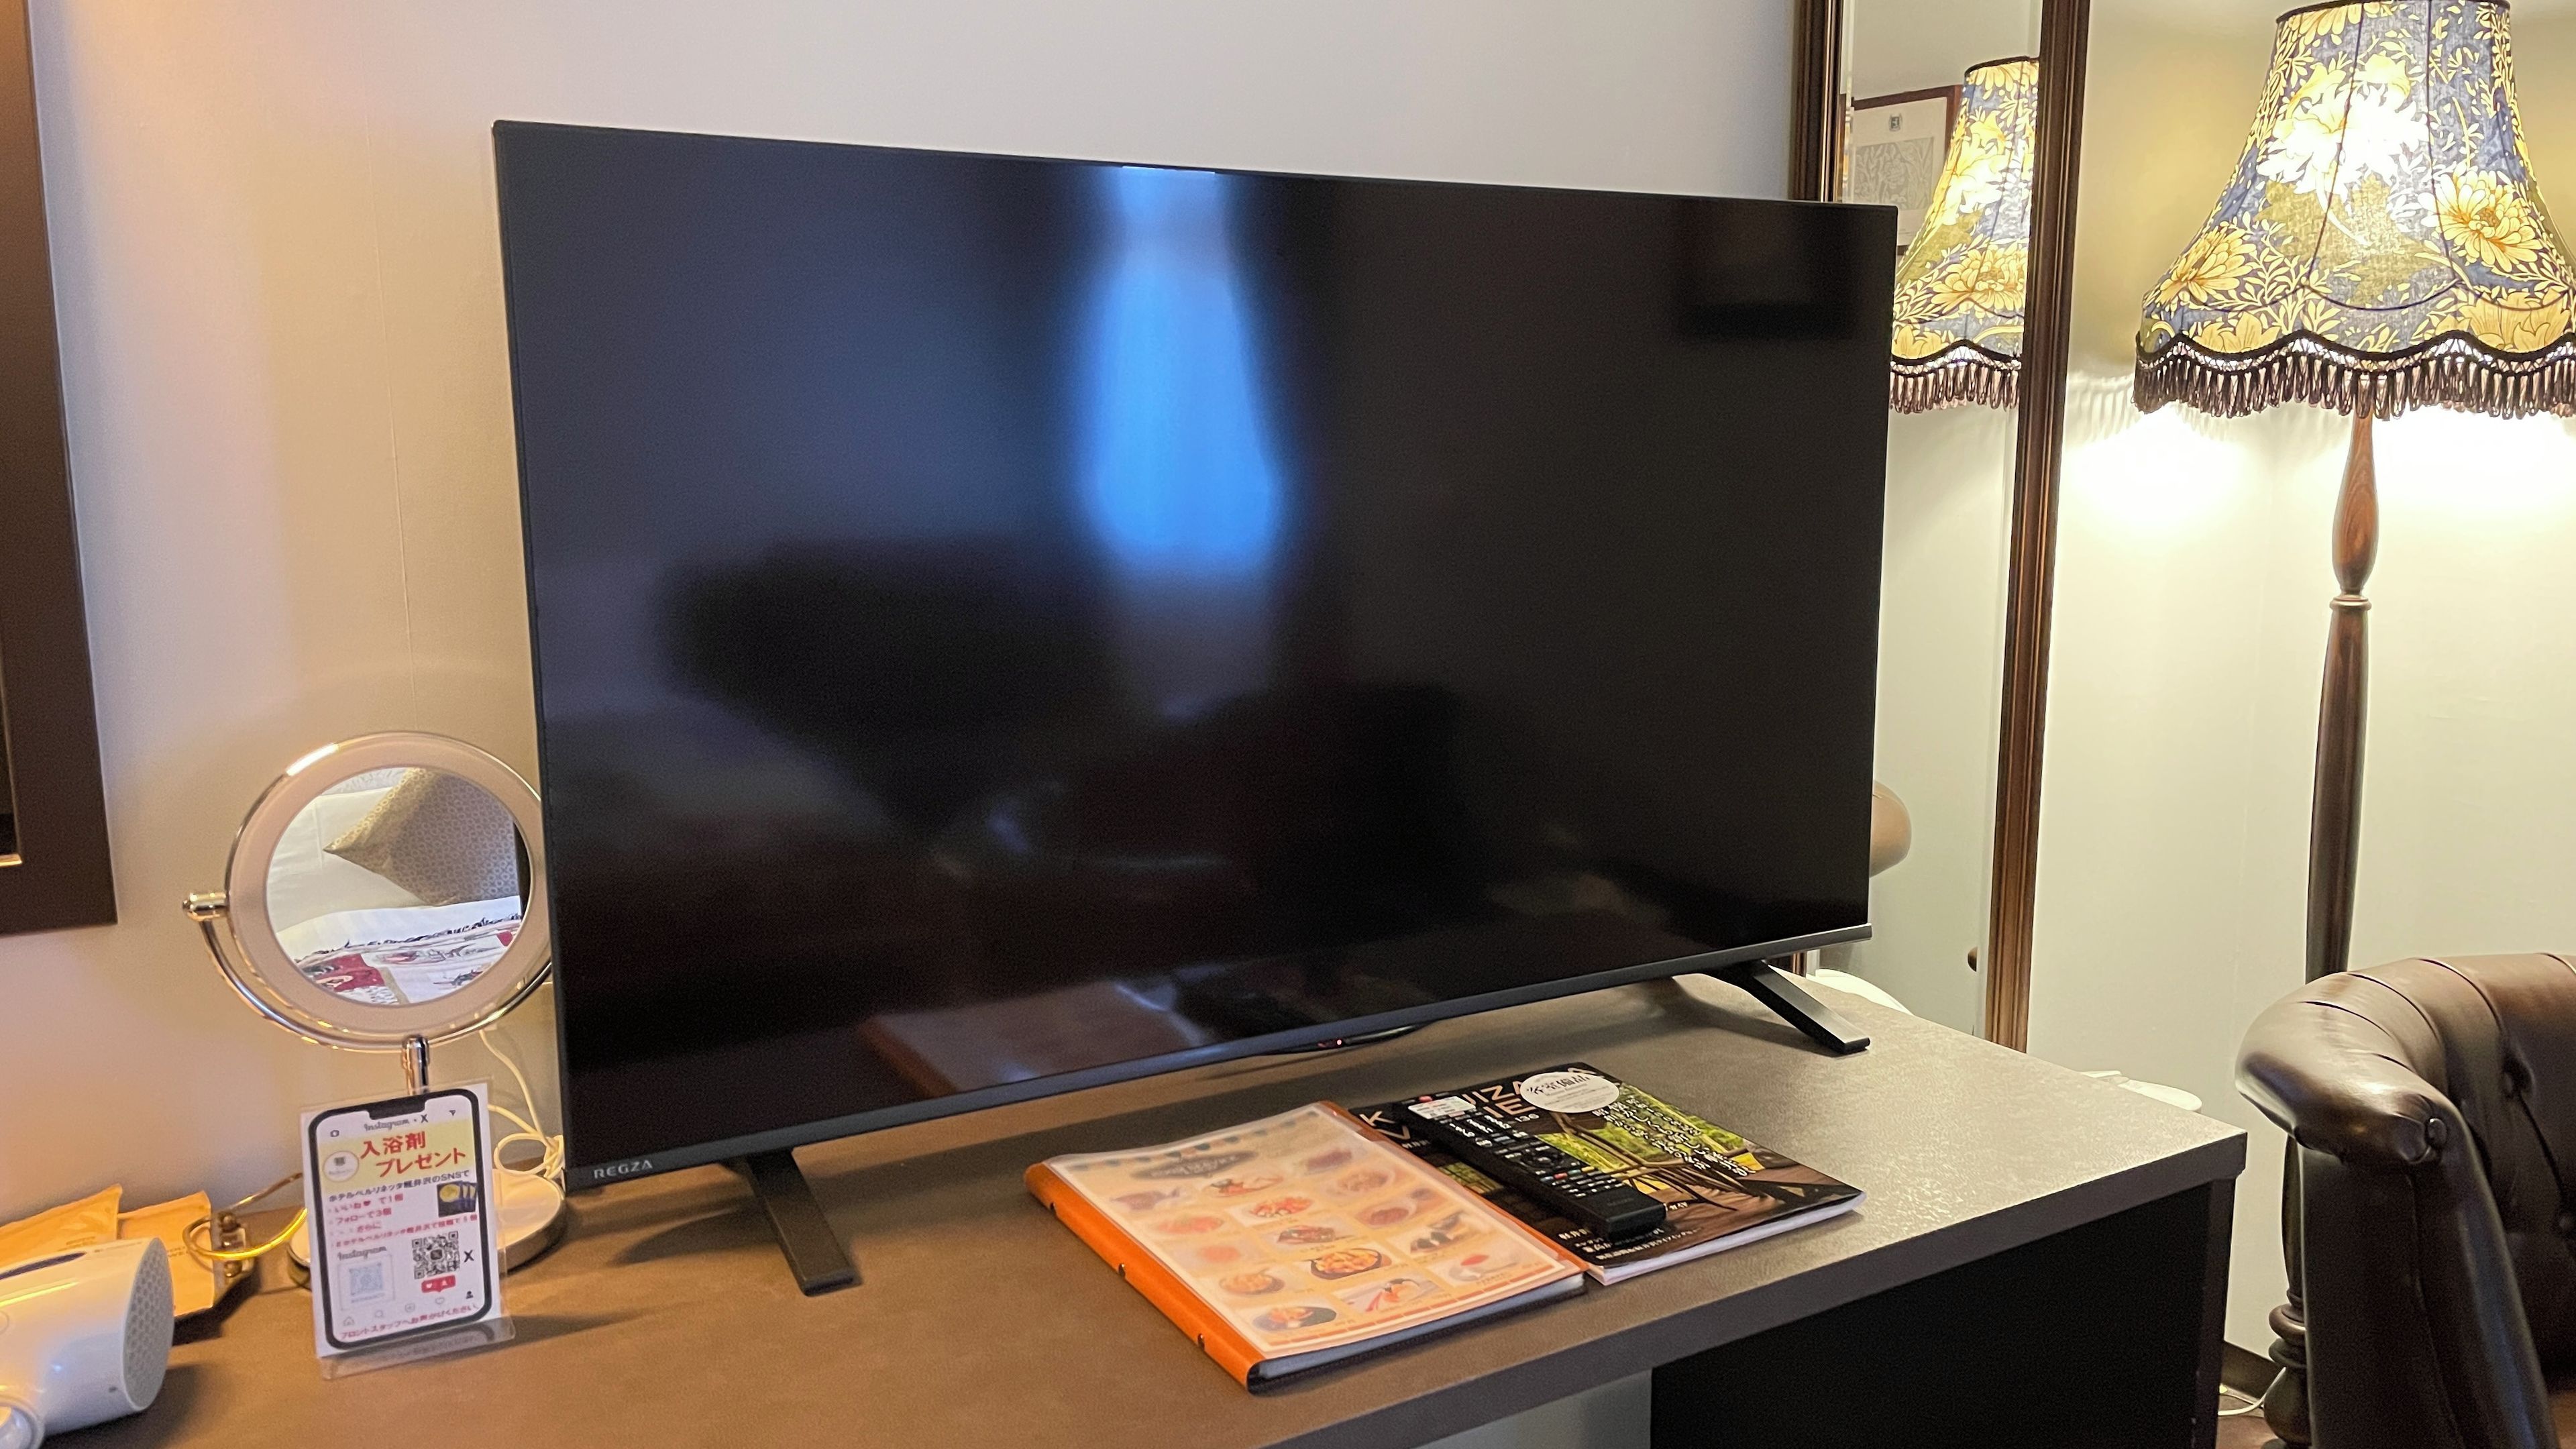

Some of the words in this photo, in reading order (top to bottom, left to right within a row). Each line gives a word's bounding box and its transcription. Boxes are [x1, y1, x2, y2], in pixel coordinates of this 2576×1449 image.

[364, 1118, 410, 1132] Instagram
[421, 1114, 429, 1123] X
[360, 1131, 426, 1160] 入浴剤
[376, 1148, 466, 1177] プレゼント
[594, 1160, 653, 1179] REGZA
[337, 1246, 387, 1260] Instagram
[464, 1249, 474, 1263] X
